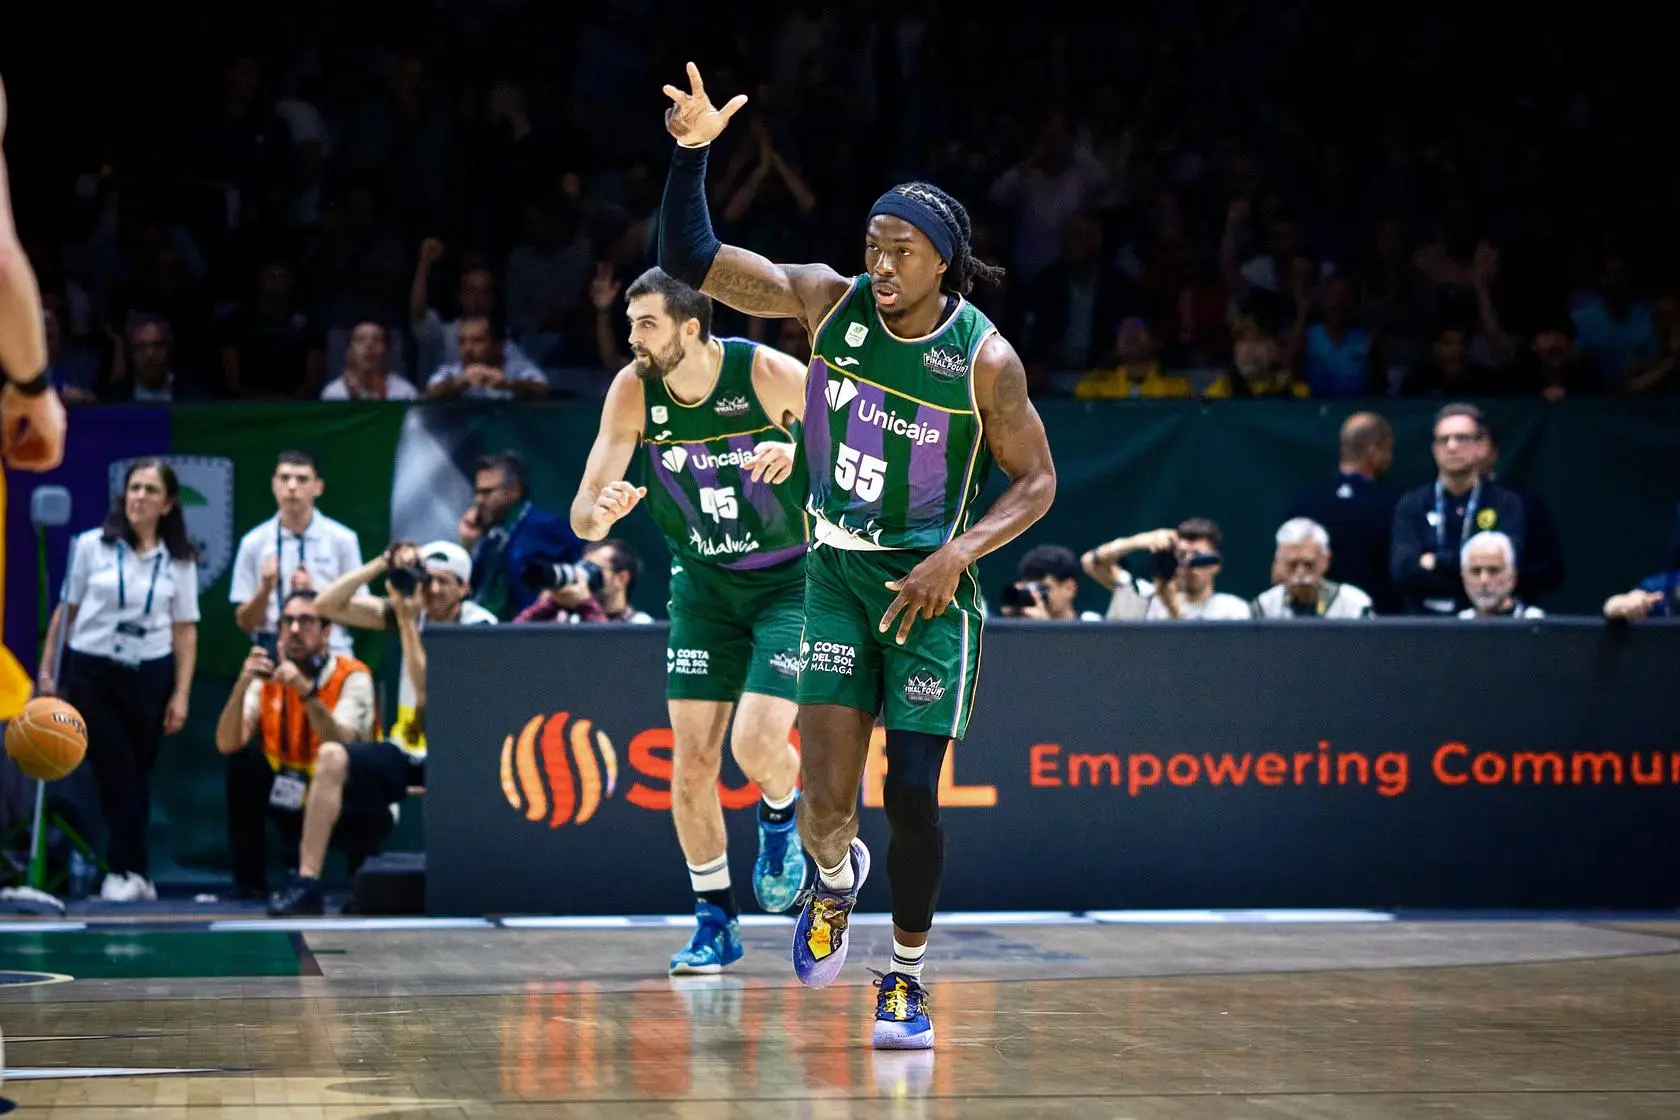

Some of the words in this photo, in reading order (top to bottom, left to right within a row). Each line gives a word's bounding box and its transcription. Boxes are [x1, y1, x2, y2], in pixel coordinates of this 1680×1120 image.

[925, 355, 947, 368] FINAL
[946, 362, 966, 373] FOUR
[858, 399, 940, 446] Unicaja
[834, 441, 888, 503] 55
[676, 648, 709, 660] COSTA
[813, 641, 856, 658] COSTA
[675, 658, 691, 667] DEL
[692, 659, 708, 668] SOL
[810, 661, 853, 676] MÁLAGA
[812, 653, 832, 663] DEL
[833, 655, 854, 668] SOL
[905, 685, 922, 693] FINAL
[1029, 740, 1409, 797] Empowering
